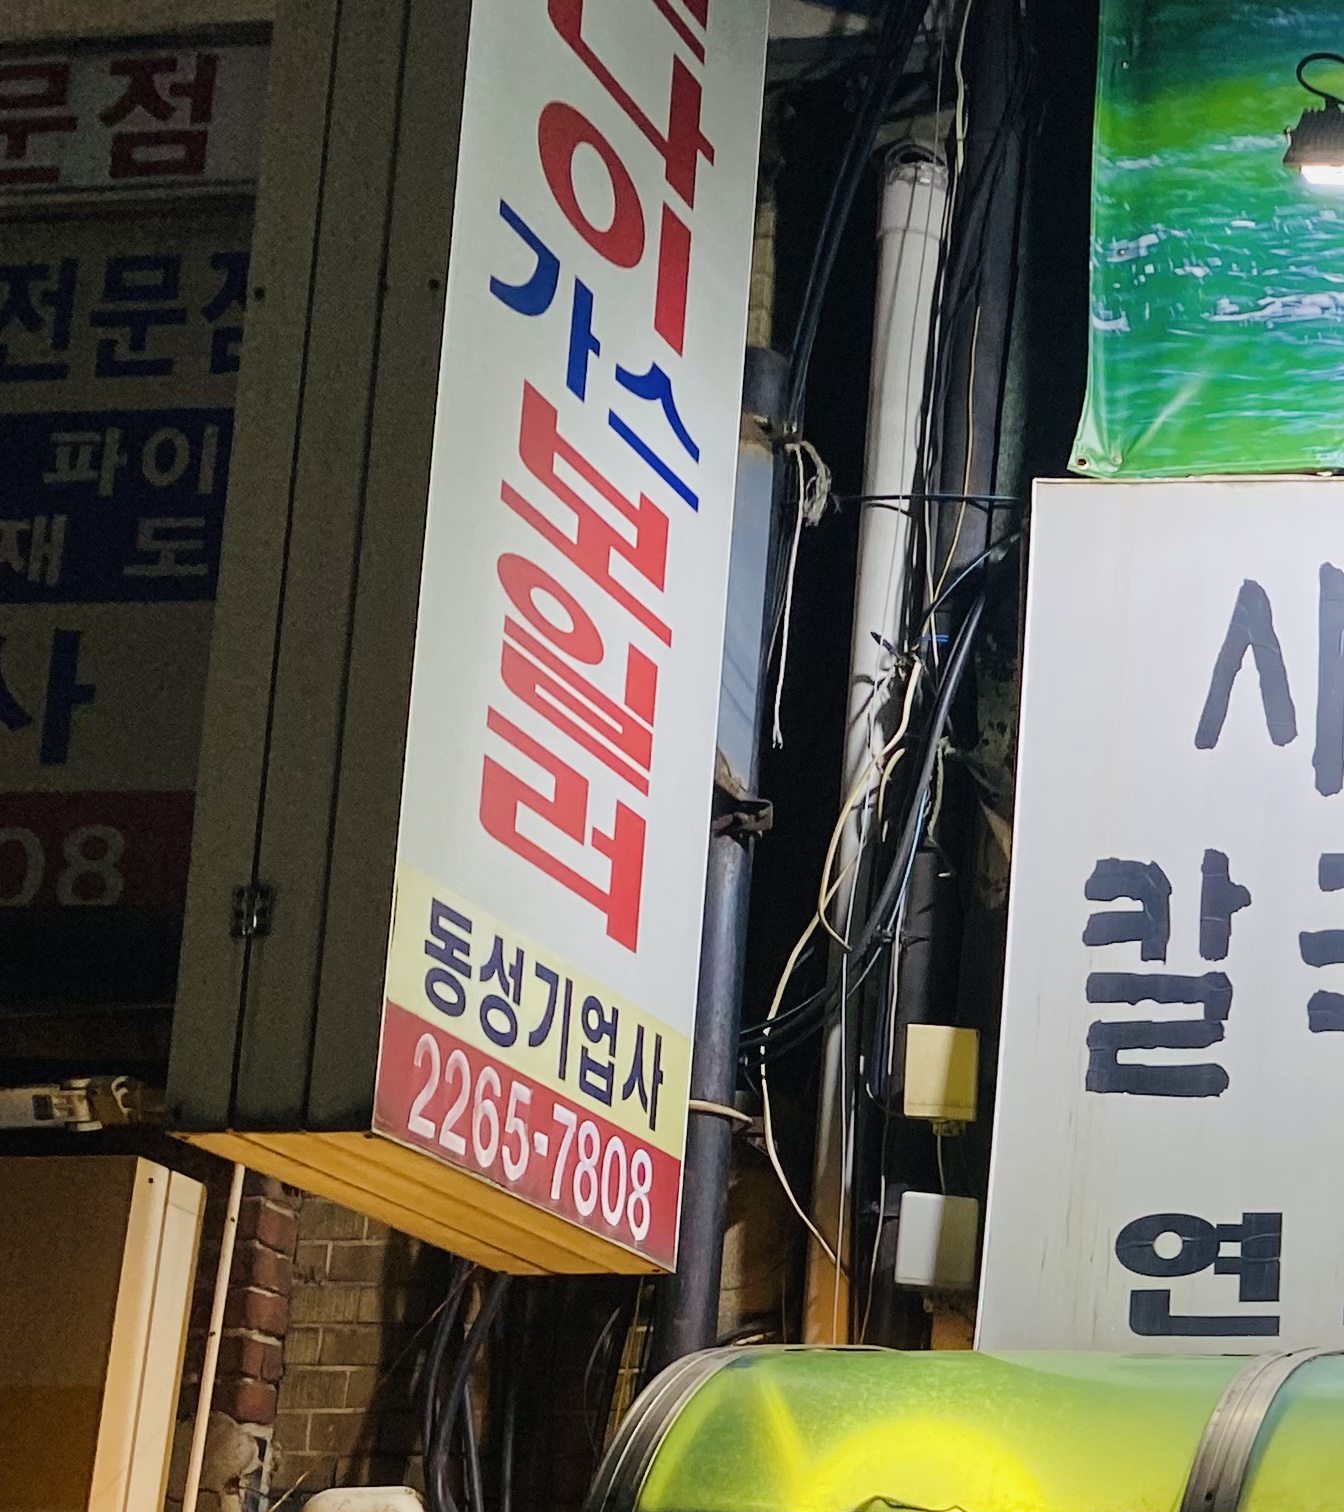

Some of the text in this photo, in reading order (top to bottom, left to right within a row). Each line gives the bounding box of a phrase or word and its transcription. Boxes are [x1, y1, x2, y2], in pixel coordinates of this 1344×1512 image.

[489, 198, 699, 513] 가스
[479, 379, 673, 954] 보일러
[407, 1033, 653, 1242] 2265-7808
[423, 897, 664, 1130] 동성기업사
